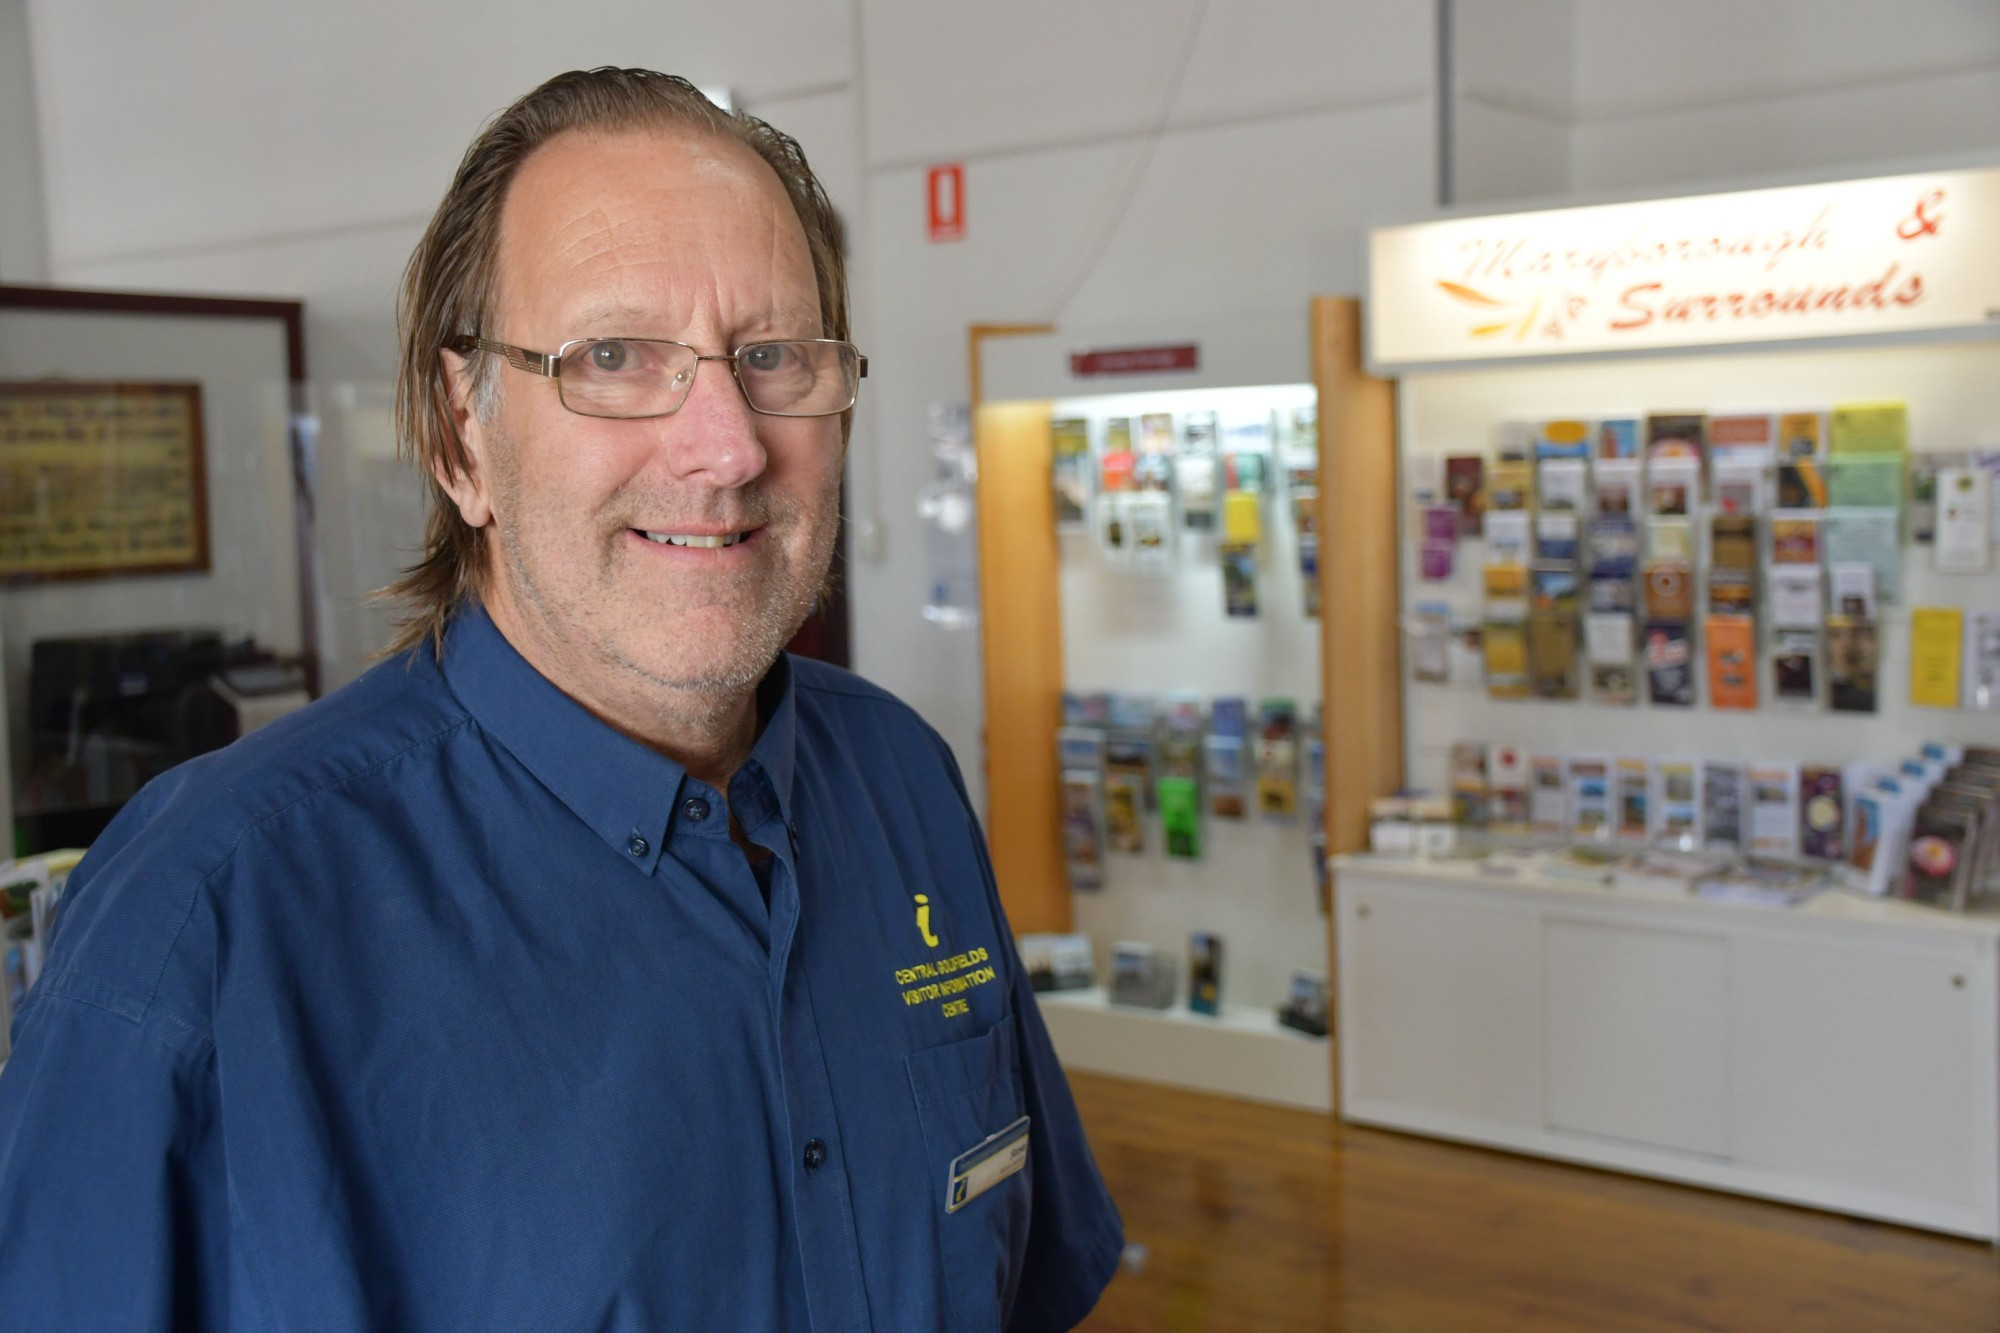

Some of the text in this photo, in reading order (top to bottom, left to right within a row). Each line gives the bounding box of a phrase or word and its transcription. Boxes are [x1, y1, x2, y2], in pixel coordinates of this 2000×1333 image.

[1459, 188, 1944, 282] Maryborough &
[1610, 263, 1923, 331] Surrounds
[896, 963, 938, 985] CENTRAL
[902, 983, 942, 1006] VISITOR
